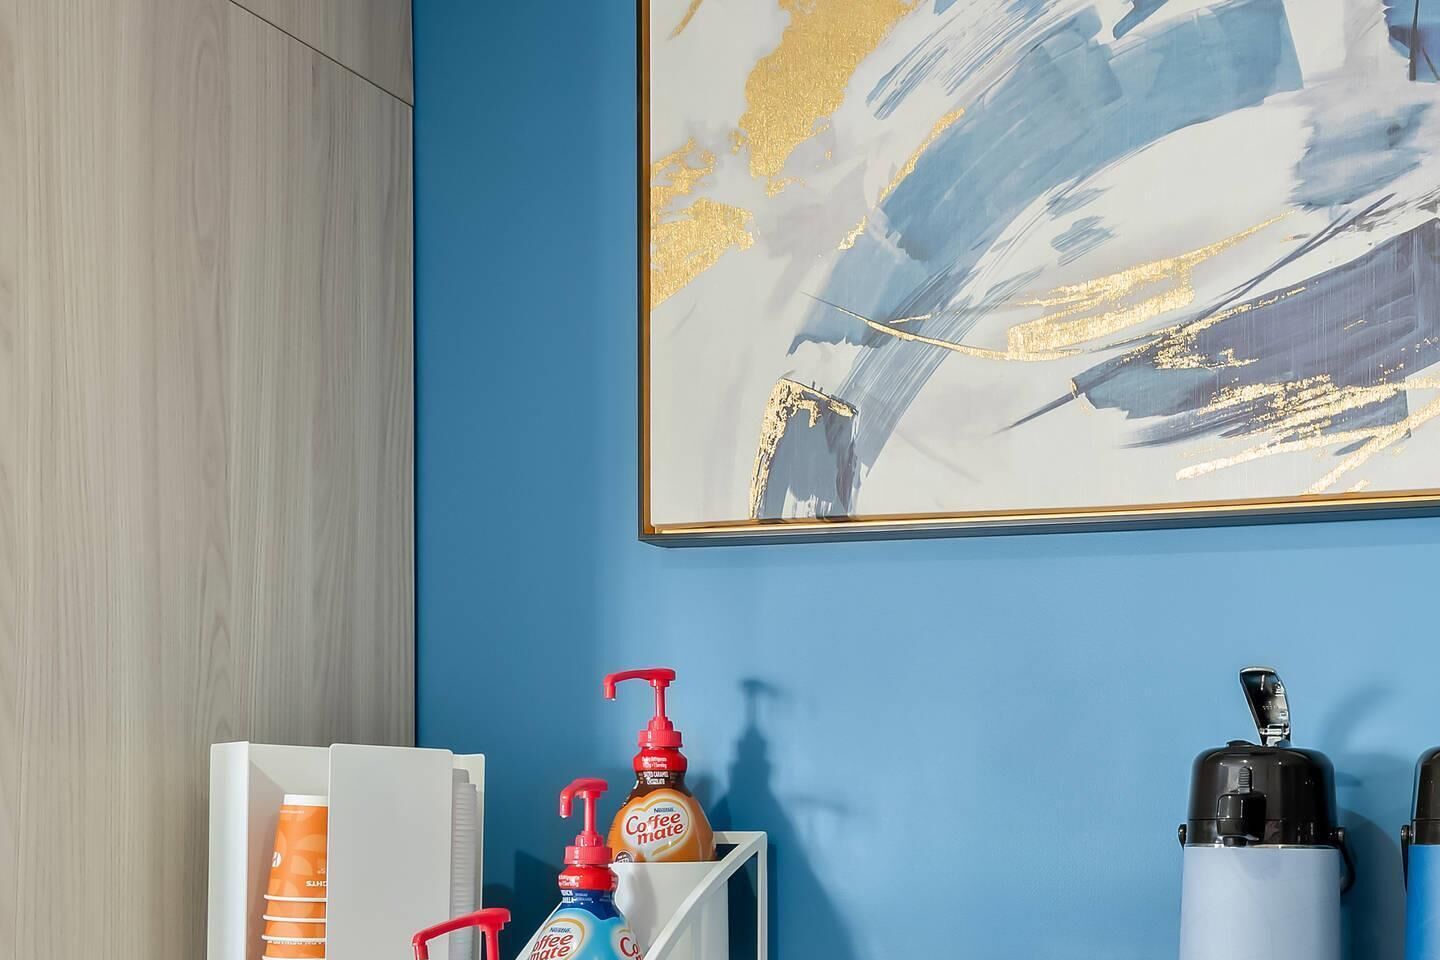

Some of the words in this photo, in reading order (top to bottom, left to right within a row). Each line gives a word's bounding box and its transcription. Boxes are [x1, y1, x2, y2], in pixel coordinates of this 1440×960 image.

[626, 813, 681, 836] Coffee
[637, 824, 684, 845] mate
[532, 934, 574, 952] offee
